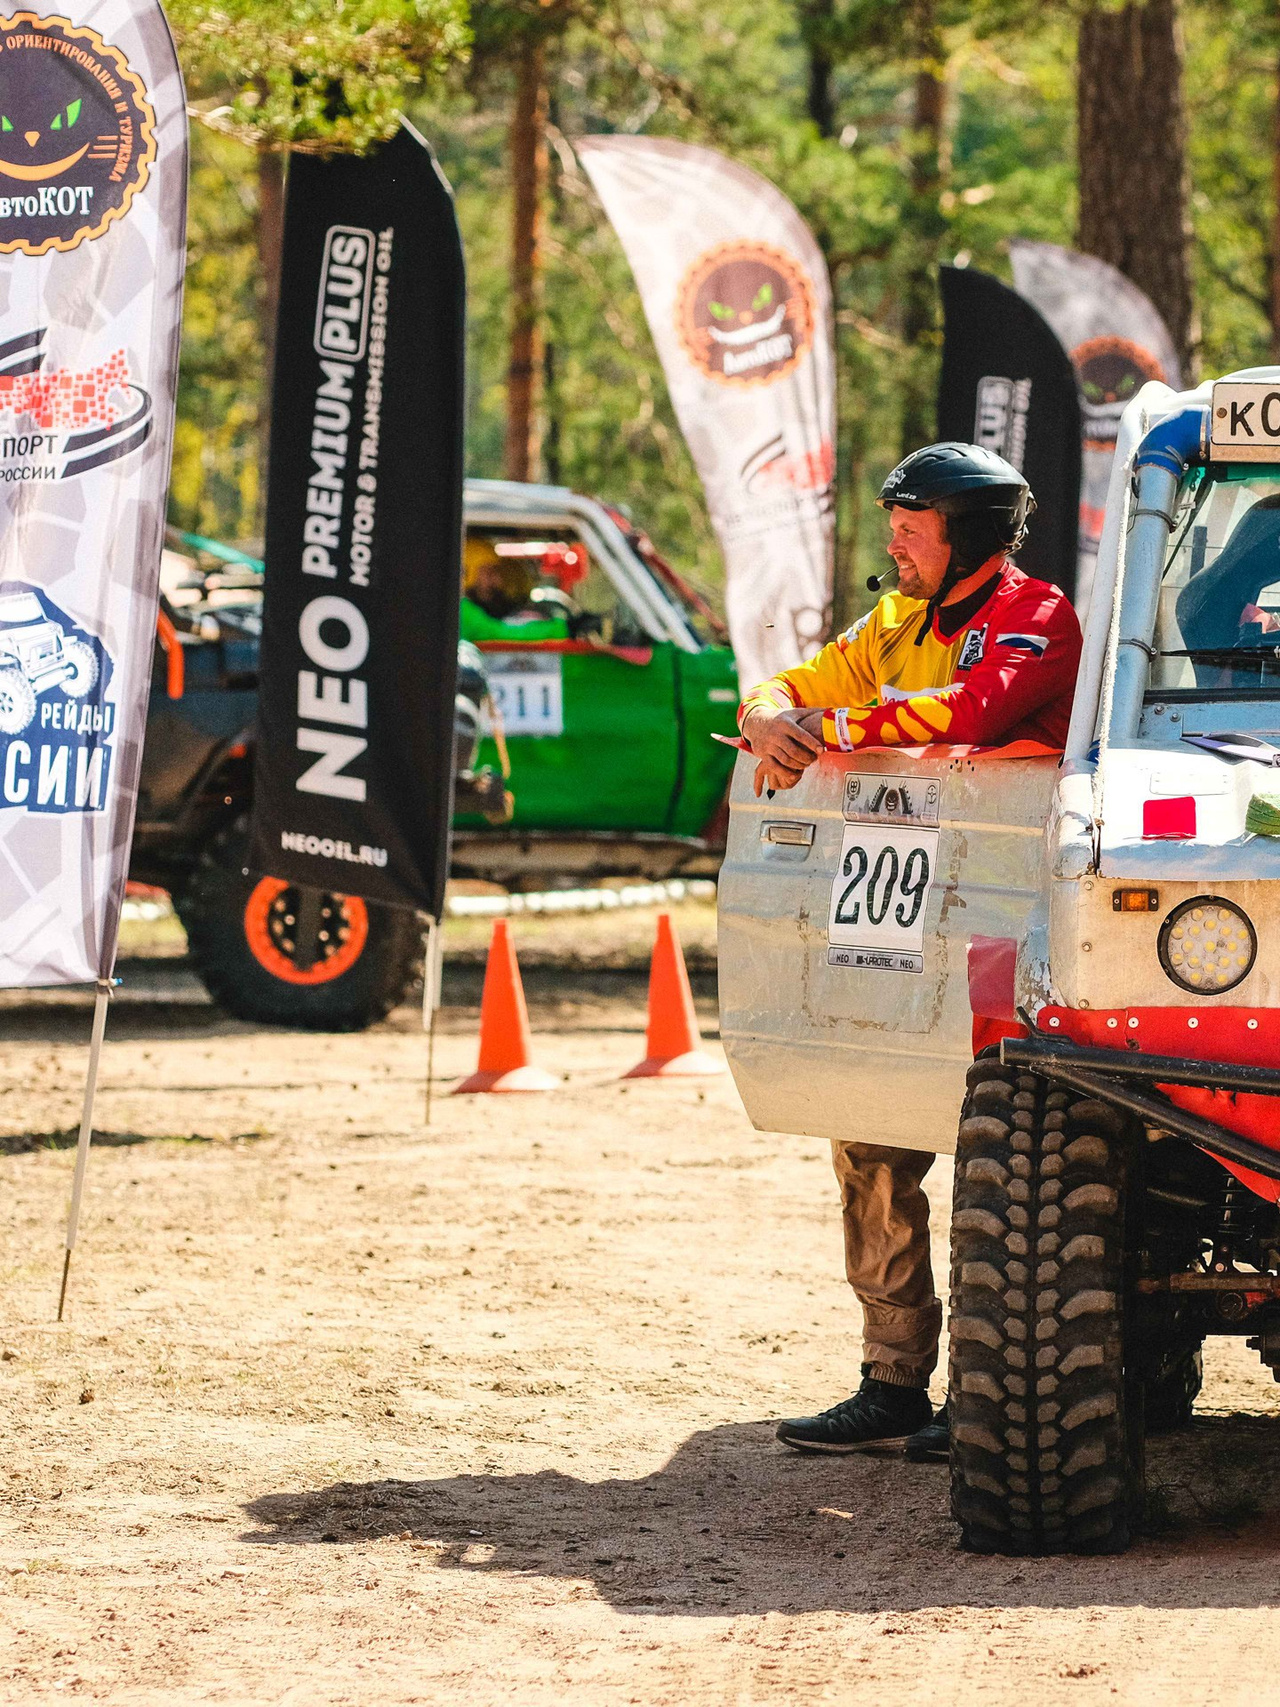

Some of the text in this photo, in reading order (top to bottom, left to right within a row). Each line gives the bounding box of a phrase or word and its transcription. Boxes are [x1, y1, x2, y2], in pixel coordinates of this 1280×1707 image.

[376, 226, 394, 272] OIL
[302, 236, 367, 578] PREMIUM PLUS
[358, 275, 389, 470] TRANSMISSION
[3, 435, 58, 457] ПОРТ
[349, 494, 376, 587] MOTOR
[41, 699, 111, 735] РЕЙДЫ
[296, 595, 370, 802] NEO
[4, 740, 103, 808] СИИ
[834, 846, 929, 928] 209
[836, 954, 850, 963] NEO
[899, 959, 914, 969] NEO
